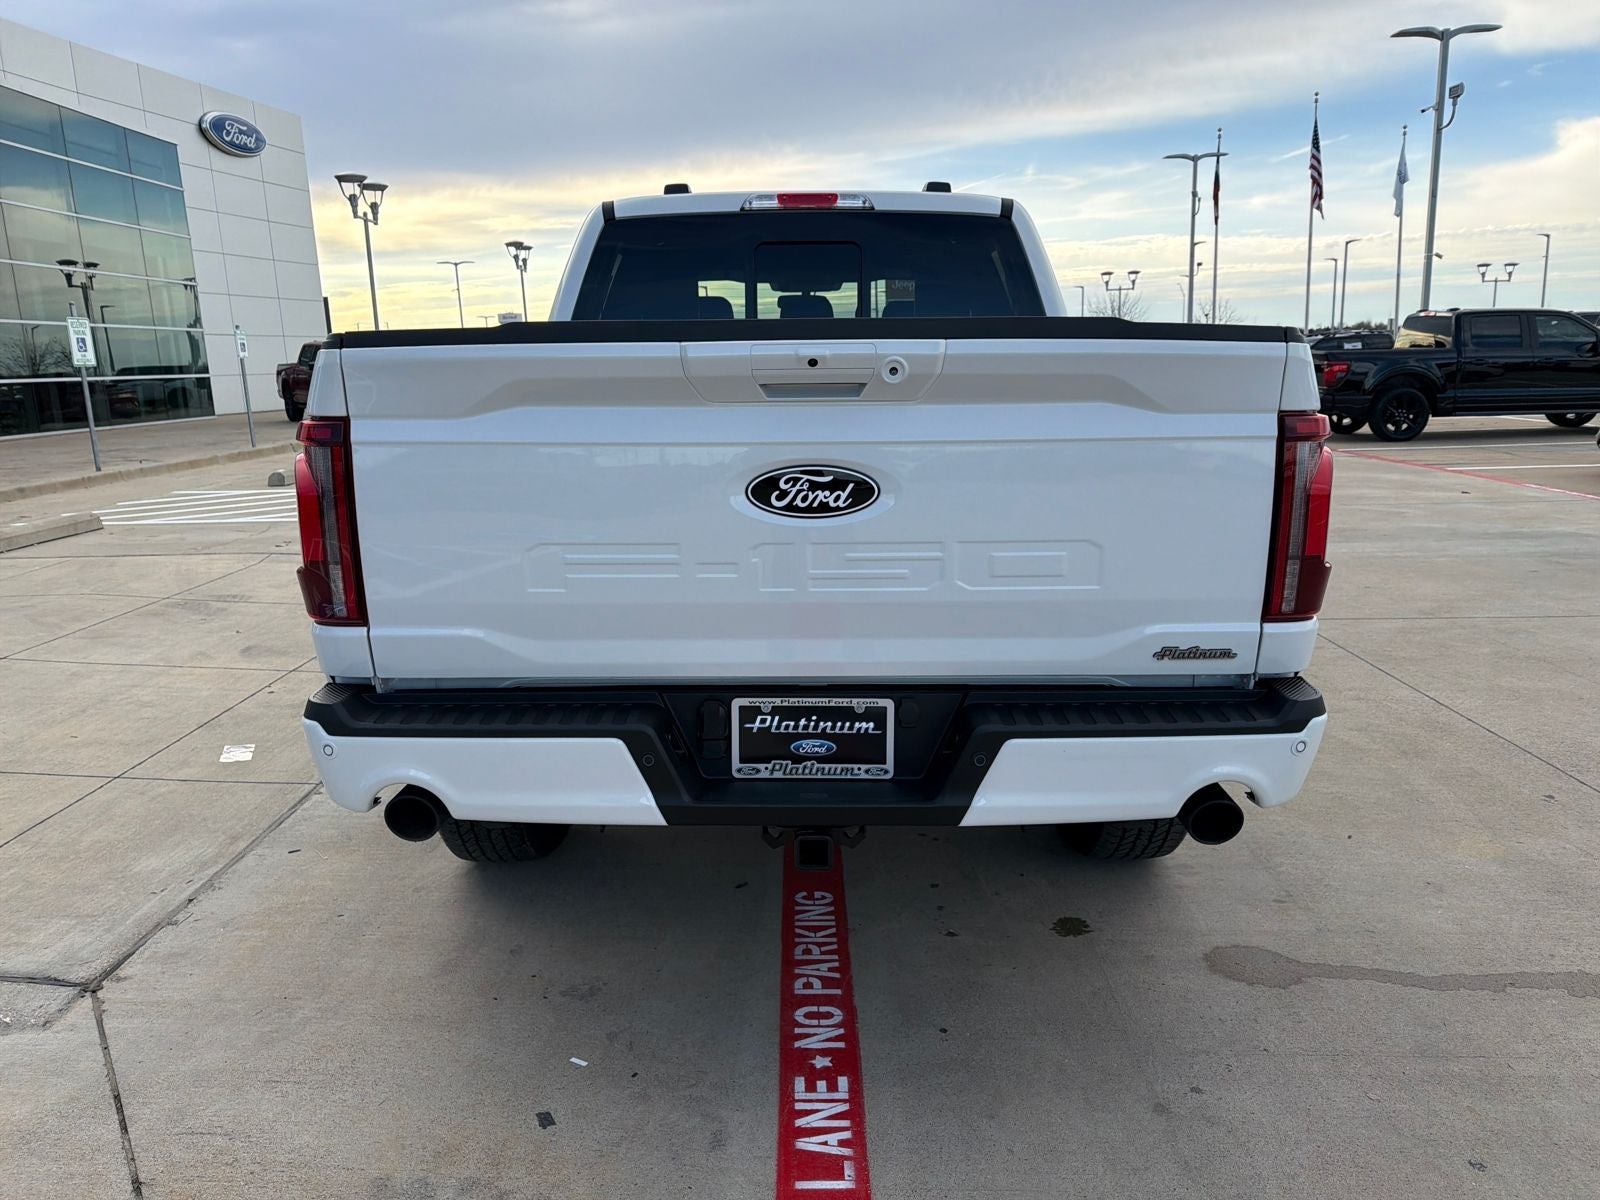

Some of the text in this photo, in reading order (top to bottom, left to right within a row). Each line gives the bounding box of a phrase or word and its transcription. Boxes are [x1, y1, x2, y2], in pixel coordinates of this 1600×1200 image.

[222, 120, 257, 149] Ford
[770, 473, 855, 508] Ford
[524, 541, 1102, 593] F-150
[1152, 645, 1238, 661] Platinum
[748, 698, 880, 706] www.PlatinumFord.com
[743, 715, 883, 734] Platinum
[799, 742, 828, 754] Ford
[769, 762, 861, 776] Platinum
[794, 890, 856, 1190] LANE NO PARKING
